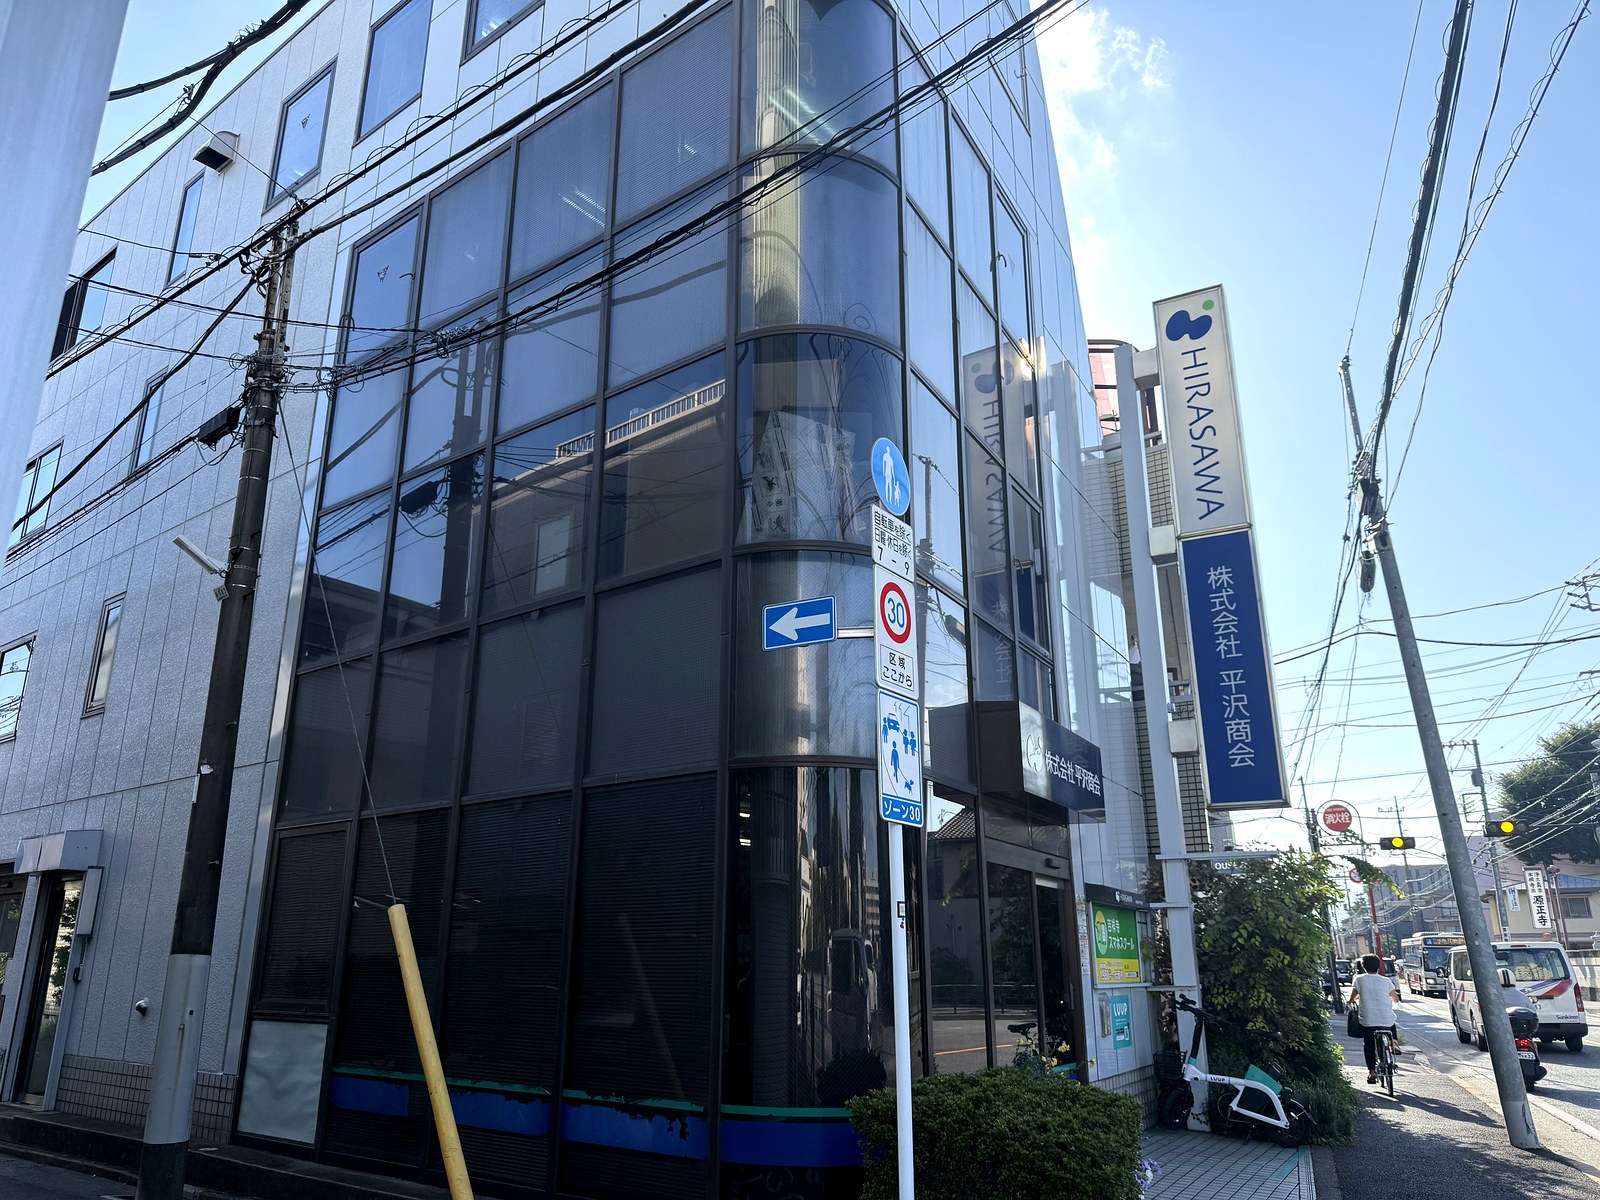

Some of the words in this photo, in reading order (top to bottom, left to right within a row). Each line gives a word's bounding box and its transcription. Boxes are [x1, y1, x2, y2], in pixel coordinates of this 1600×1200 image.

[1181, 346, 1225, 520] HIRASAWA
[877, 545, 884, 561] 7
[904, 561, 910, 576] 9
[887, 597, 905, 628] 30
[1207, 565, 1242, 659] 株式会社
[882, 665, 913, 687] ここから
[888, 652, 906, 670] 区域
[1219, 669, 1255, 768] 平沢商会
[1045, 749, 1076, 784] 株式会社
[1074, 764, 1101, 796] 平沢商会
[884, 800, 920, 821] ゾーン30
[1324, 811, 1351, 825] 消火栓
[1532, 895, 1548, 927] 源正寺
[1108, 936, 1135, 950] スマホスクール
[1113, 1002, 1128, 1017] LUUP
